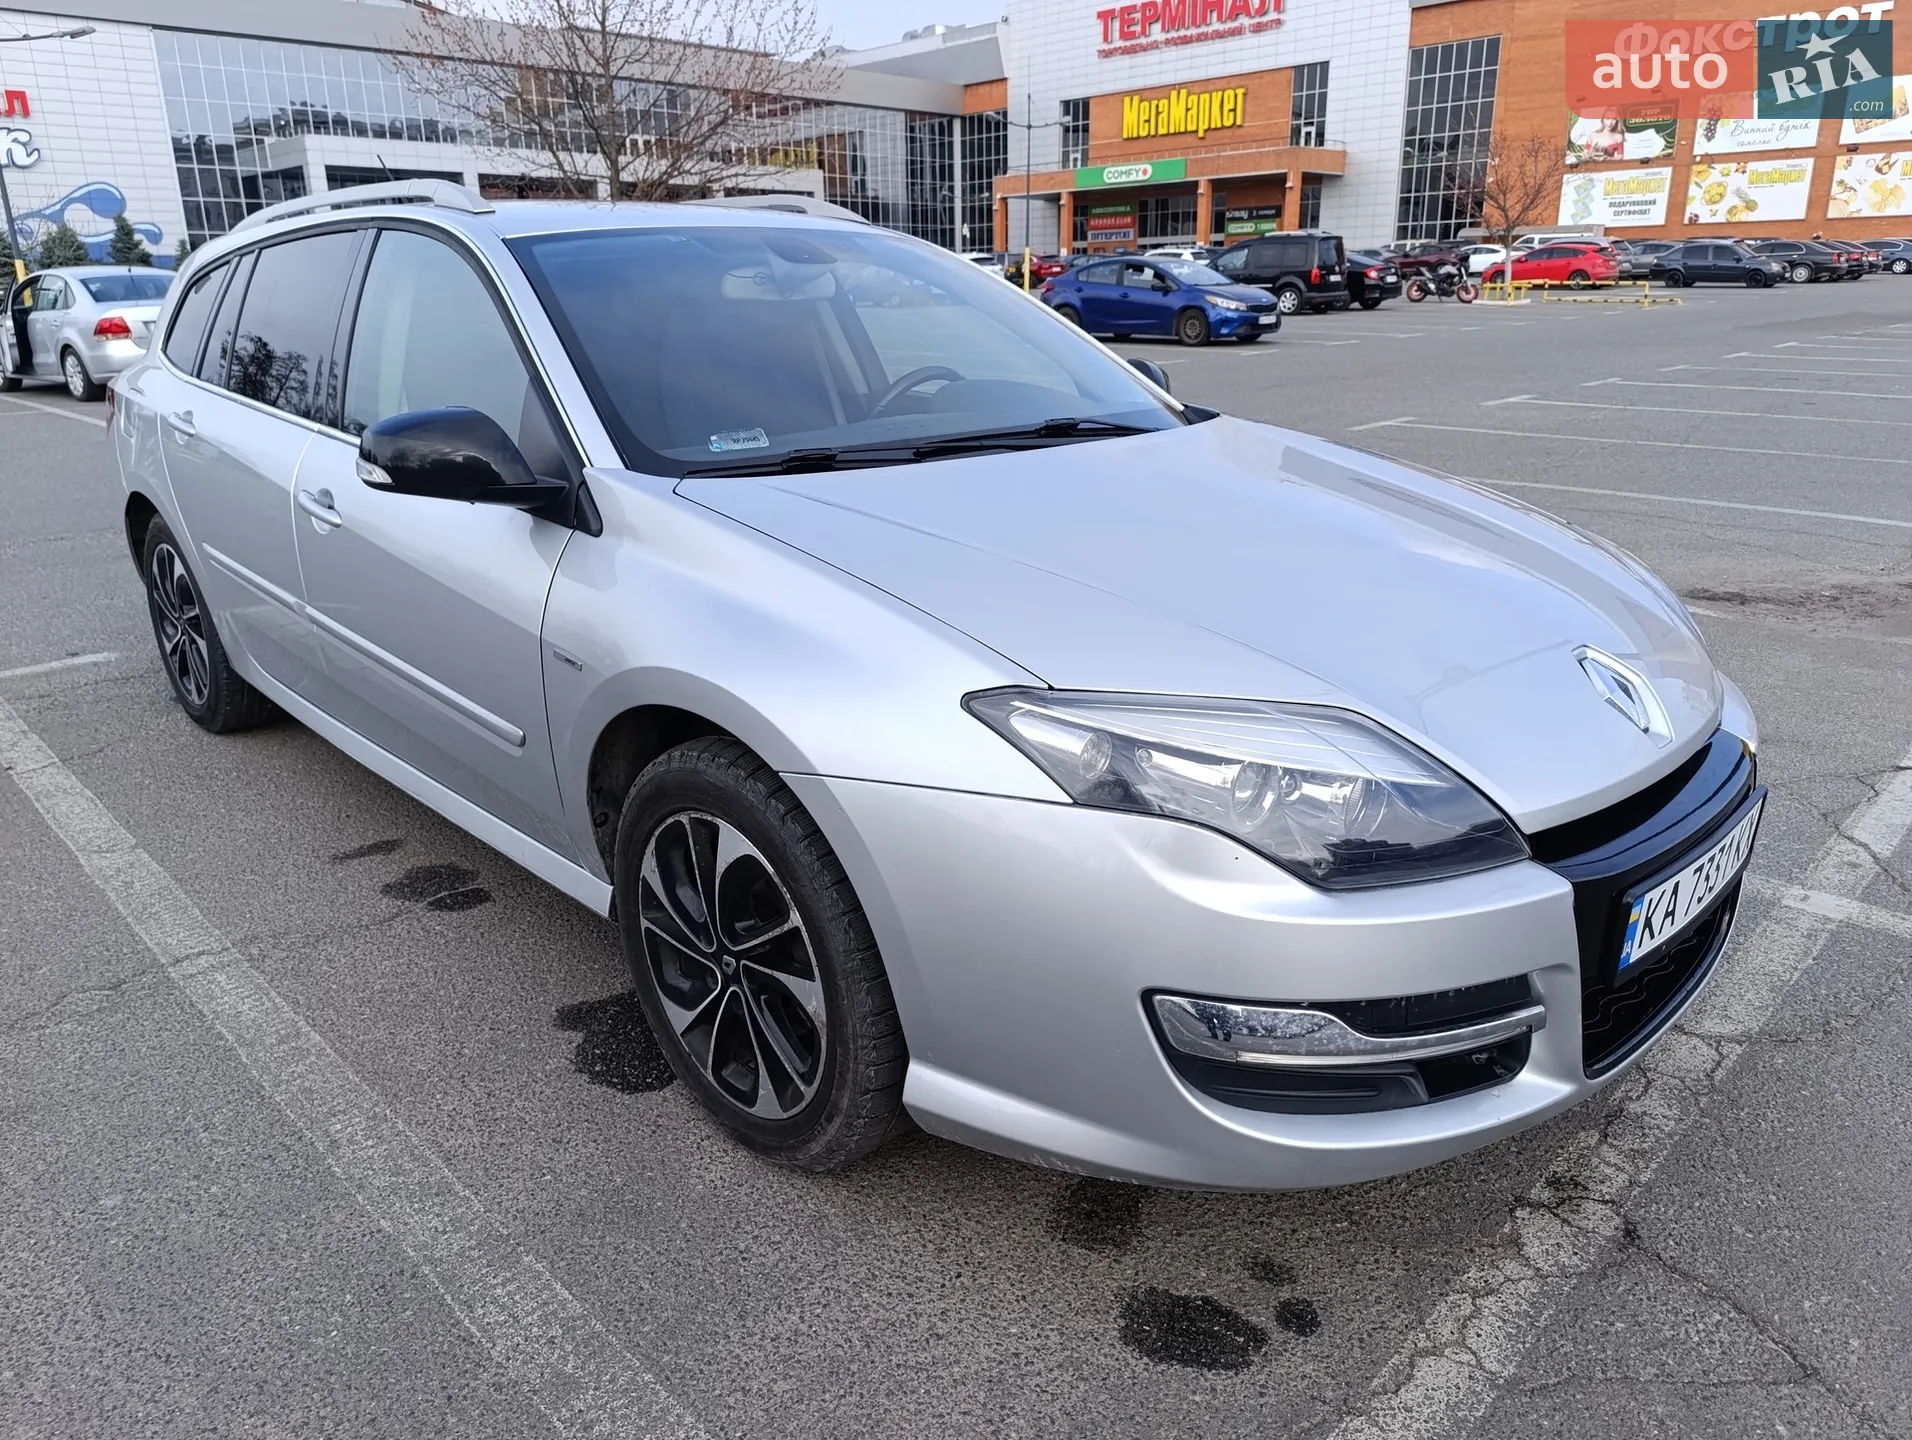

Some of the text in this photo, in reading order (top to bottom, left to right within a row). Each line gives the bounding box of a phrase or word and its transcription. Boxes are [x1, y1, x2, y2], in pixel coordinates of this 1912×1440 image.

[1122, 87, 1246, 139] МегаМаркет
[1105, 167, 1142, 181] COMFY
[1748, 167, 1807, 186] МегаМаркет
[1638, 880, 1681, 950] KA
[1684, 832, 1736, 918] 7331
